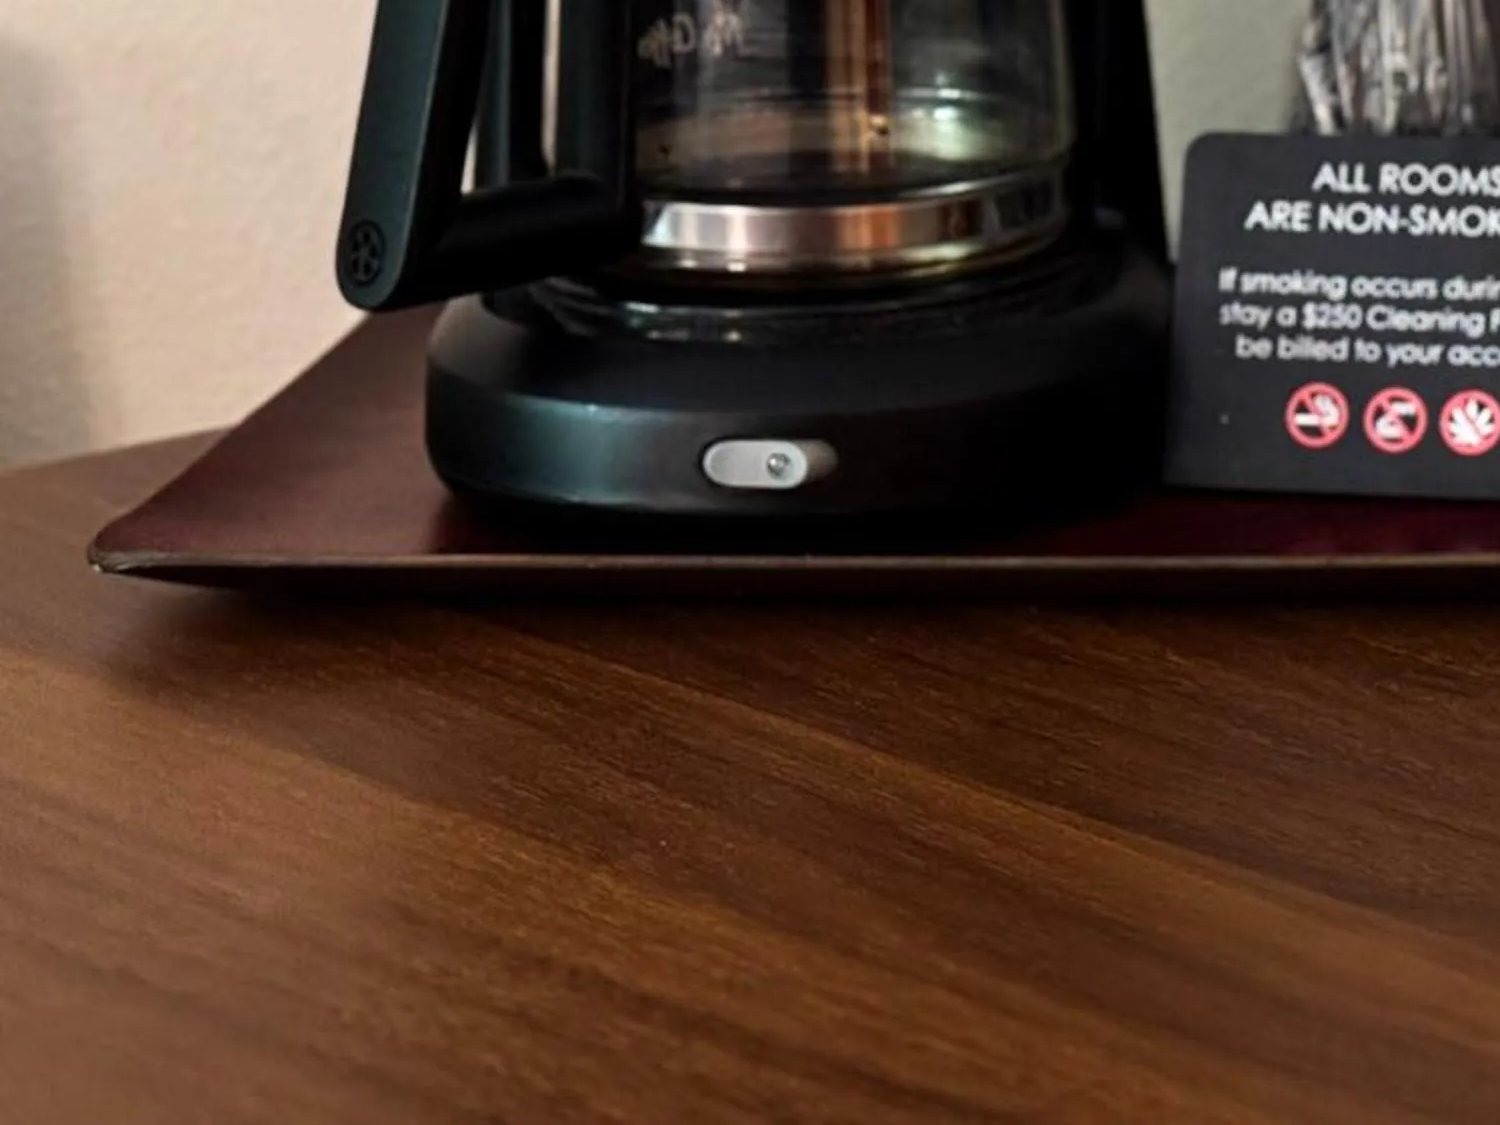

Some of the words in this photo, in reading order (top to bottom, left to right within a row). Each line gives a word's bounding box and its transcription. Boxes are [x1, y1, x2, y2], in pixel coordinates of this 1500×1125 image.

[1312, 163, 1371, 193] ALL
[1244, 201, 1312, 232] ARE
[1218, 266, 1238, 292] If
[1240, 269, 1348, 301] smoking
[1351, 275, 1438, 299] occurs
[1219, 301, 1273, 332] stay
[1276, 306, 1297, 328] a
[1302, 301, 1363, 331] $250
[1366, 304, 1486, 339] Cleaning
[1235, 333, 1273, 360] be
[1276, 334, 1350, 361] billed
[1353, 338, 1382, 363] to
[1385, 343, 1444, 368] your
